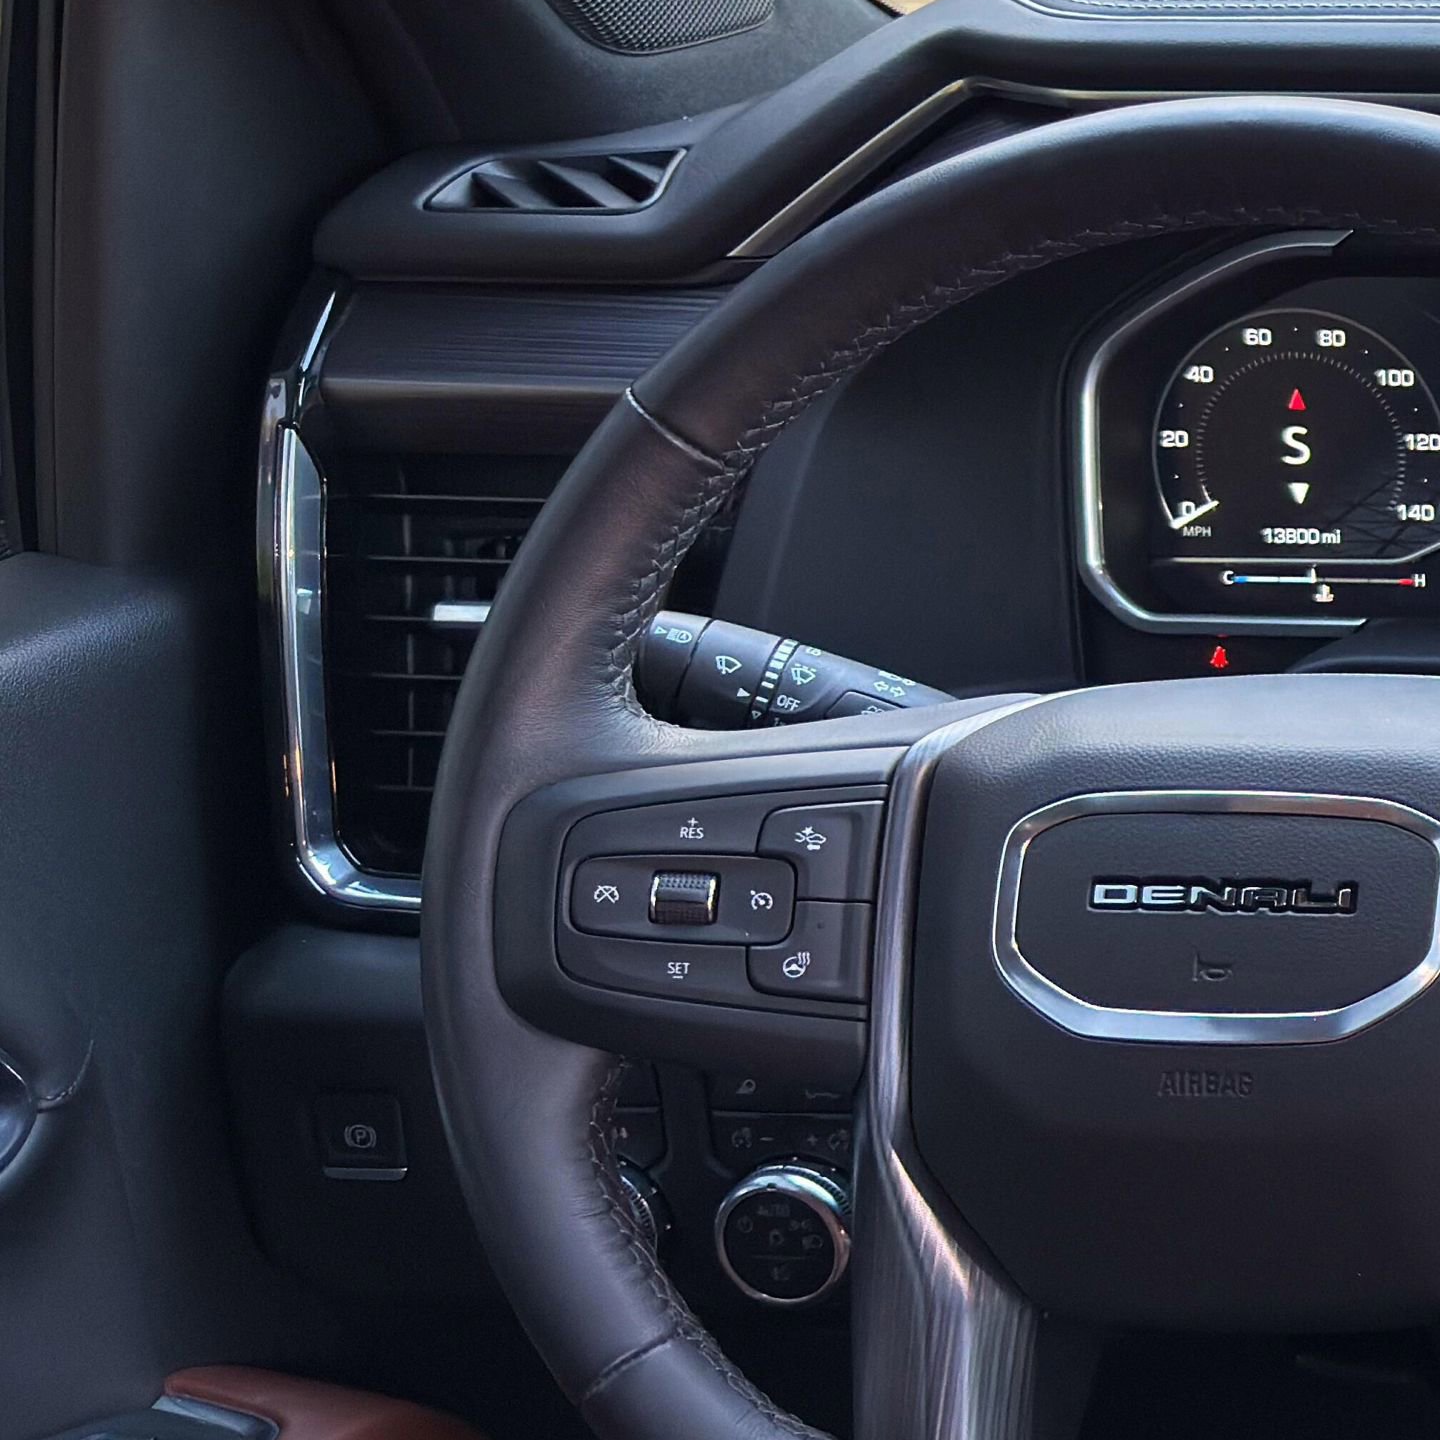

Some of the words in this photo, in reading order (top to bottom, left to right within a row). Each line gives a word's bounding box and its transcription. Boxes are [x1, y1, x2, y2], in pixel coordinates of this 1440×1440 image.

[1242, 328, 1272, 346] 60
[1316, 329, 1346, 348] 80
[1183, 365, 1214, 383] 40
[1374, 369, 1414, 387] 100
[1160, 430, 1189, 447] 20
[1280, 425, 1311, 465] S
[1396, 504, 1435, 521] 140
[1182, 526, 1212, 537] MPH
[1260, 528, 1320, 544] 13800
[1321, 529, 1341, 544] mi
[1220, 570, 1234, 585] C
[1413, 573, 1426, 587] H
[776, 693, 801, 711] OFF
[680, 827, 704, 839] RES
[1091, 879, 1355, 911] DENALI
[667, 962, 691, 974] SET
[1156, 1071, 1253, 1098] AIRBAG
